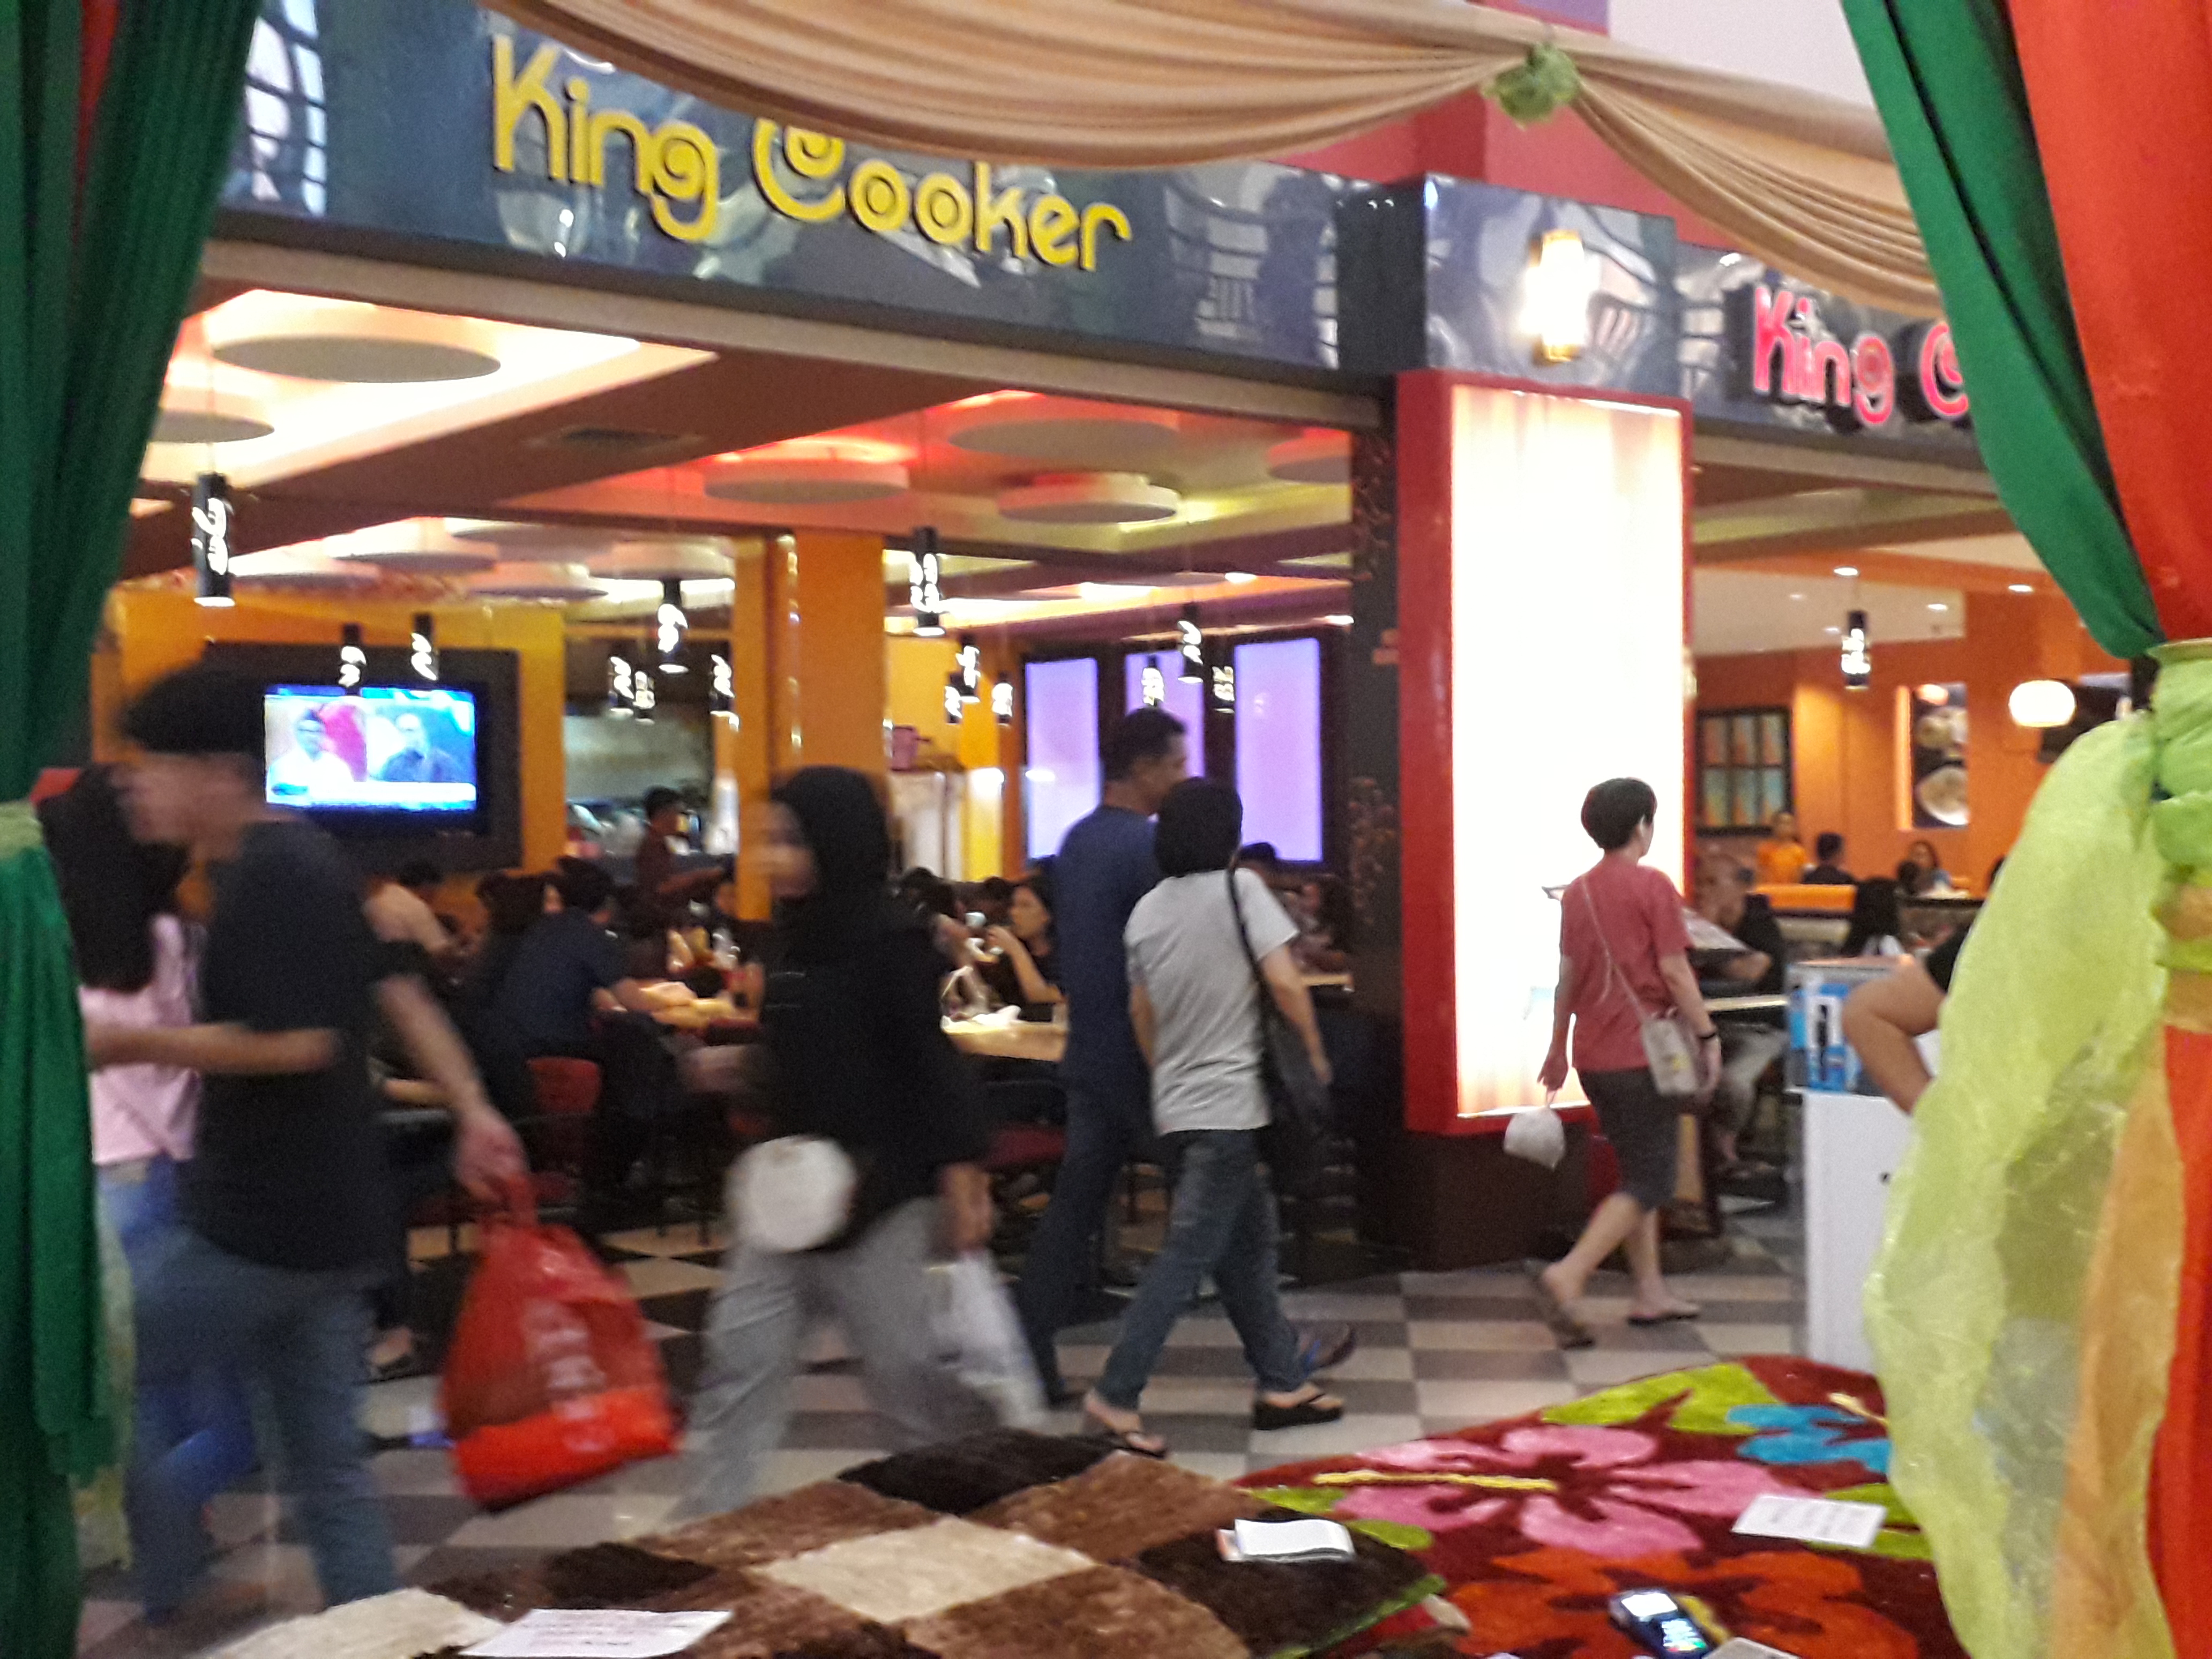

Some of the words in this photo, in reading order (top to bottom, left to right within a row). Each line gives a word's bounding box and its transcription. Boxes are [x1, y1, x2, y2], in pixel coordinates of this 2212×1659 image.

[493, 35, 718, 241] King
[752, 119, 1132, 270] Cooker
[1754, 287, 1894, 424] King
